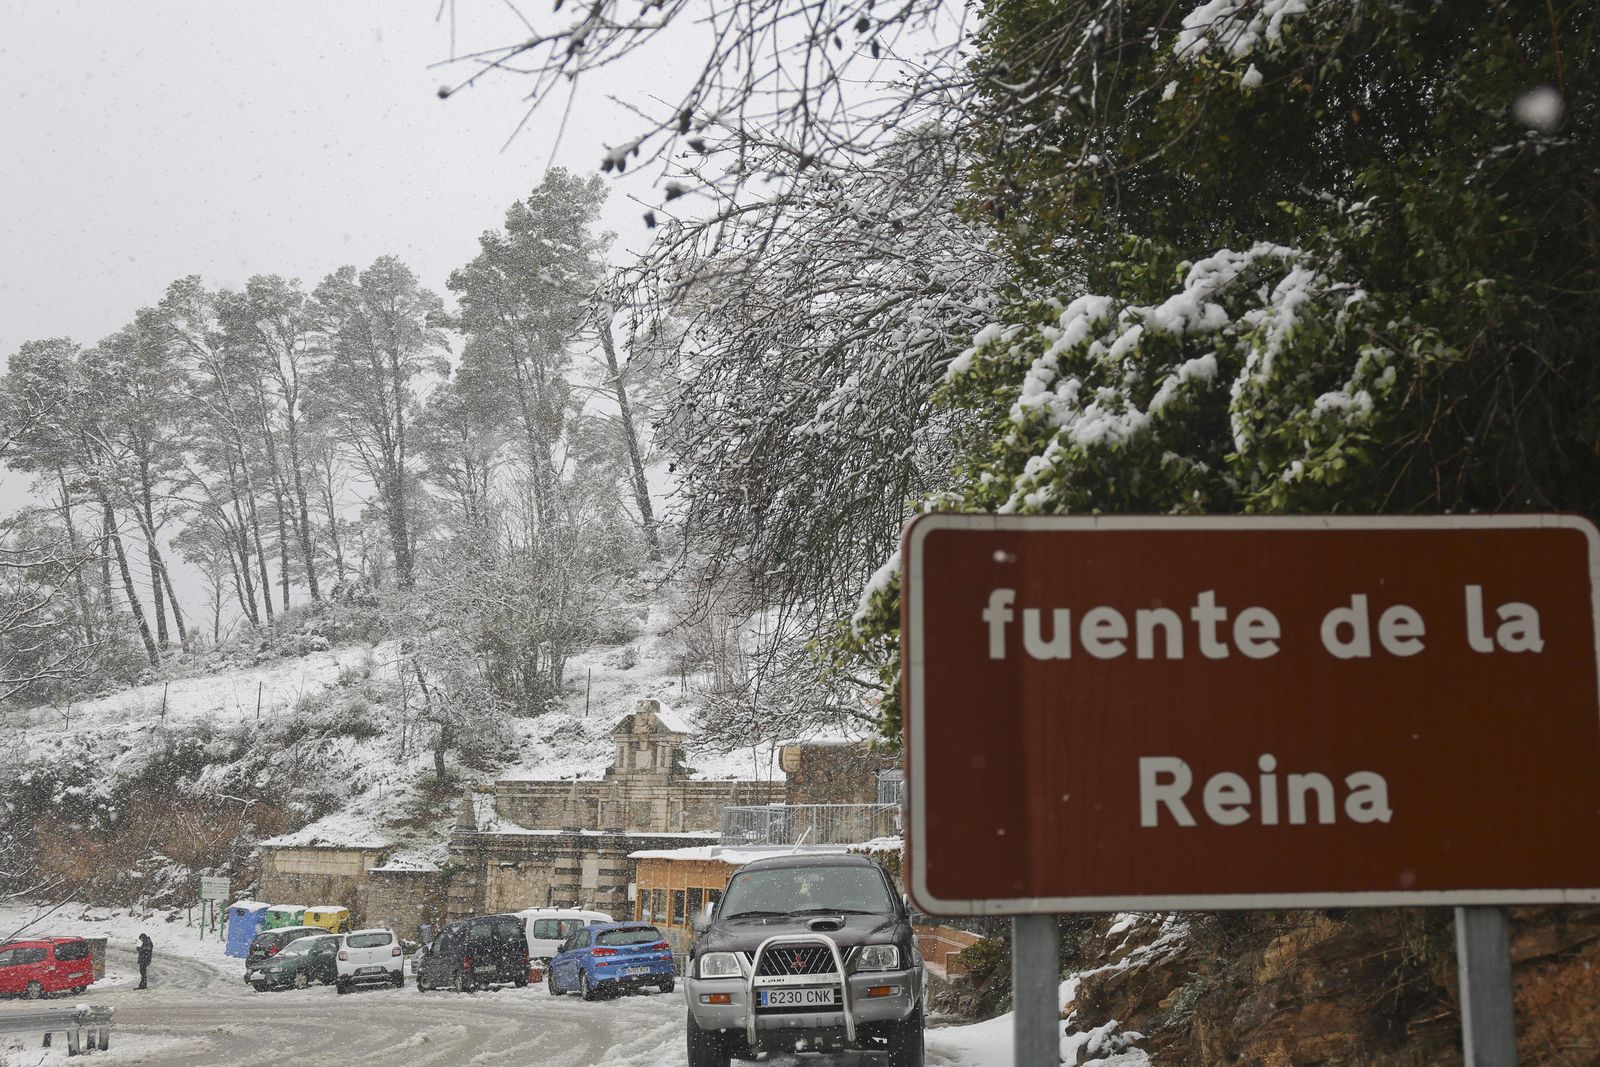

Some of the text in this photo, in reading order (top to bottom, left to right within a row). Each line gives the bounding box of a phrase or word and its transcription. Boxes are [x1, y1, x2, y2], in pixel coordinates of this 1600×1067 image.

[982, 585, 1545, 660] fuente de la
[1138, 753, 1393, 827] Reina
[769, 990, 831, 1004] 6230 CNK
